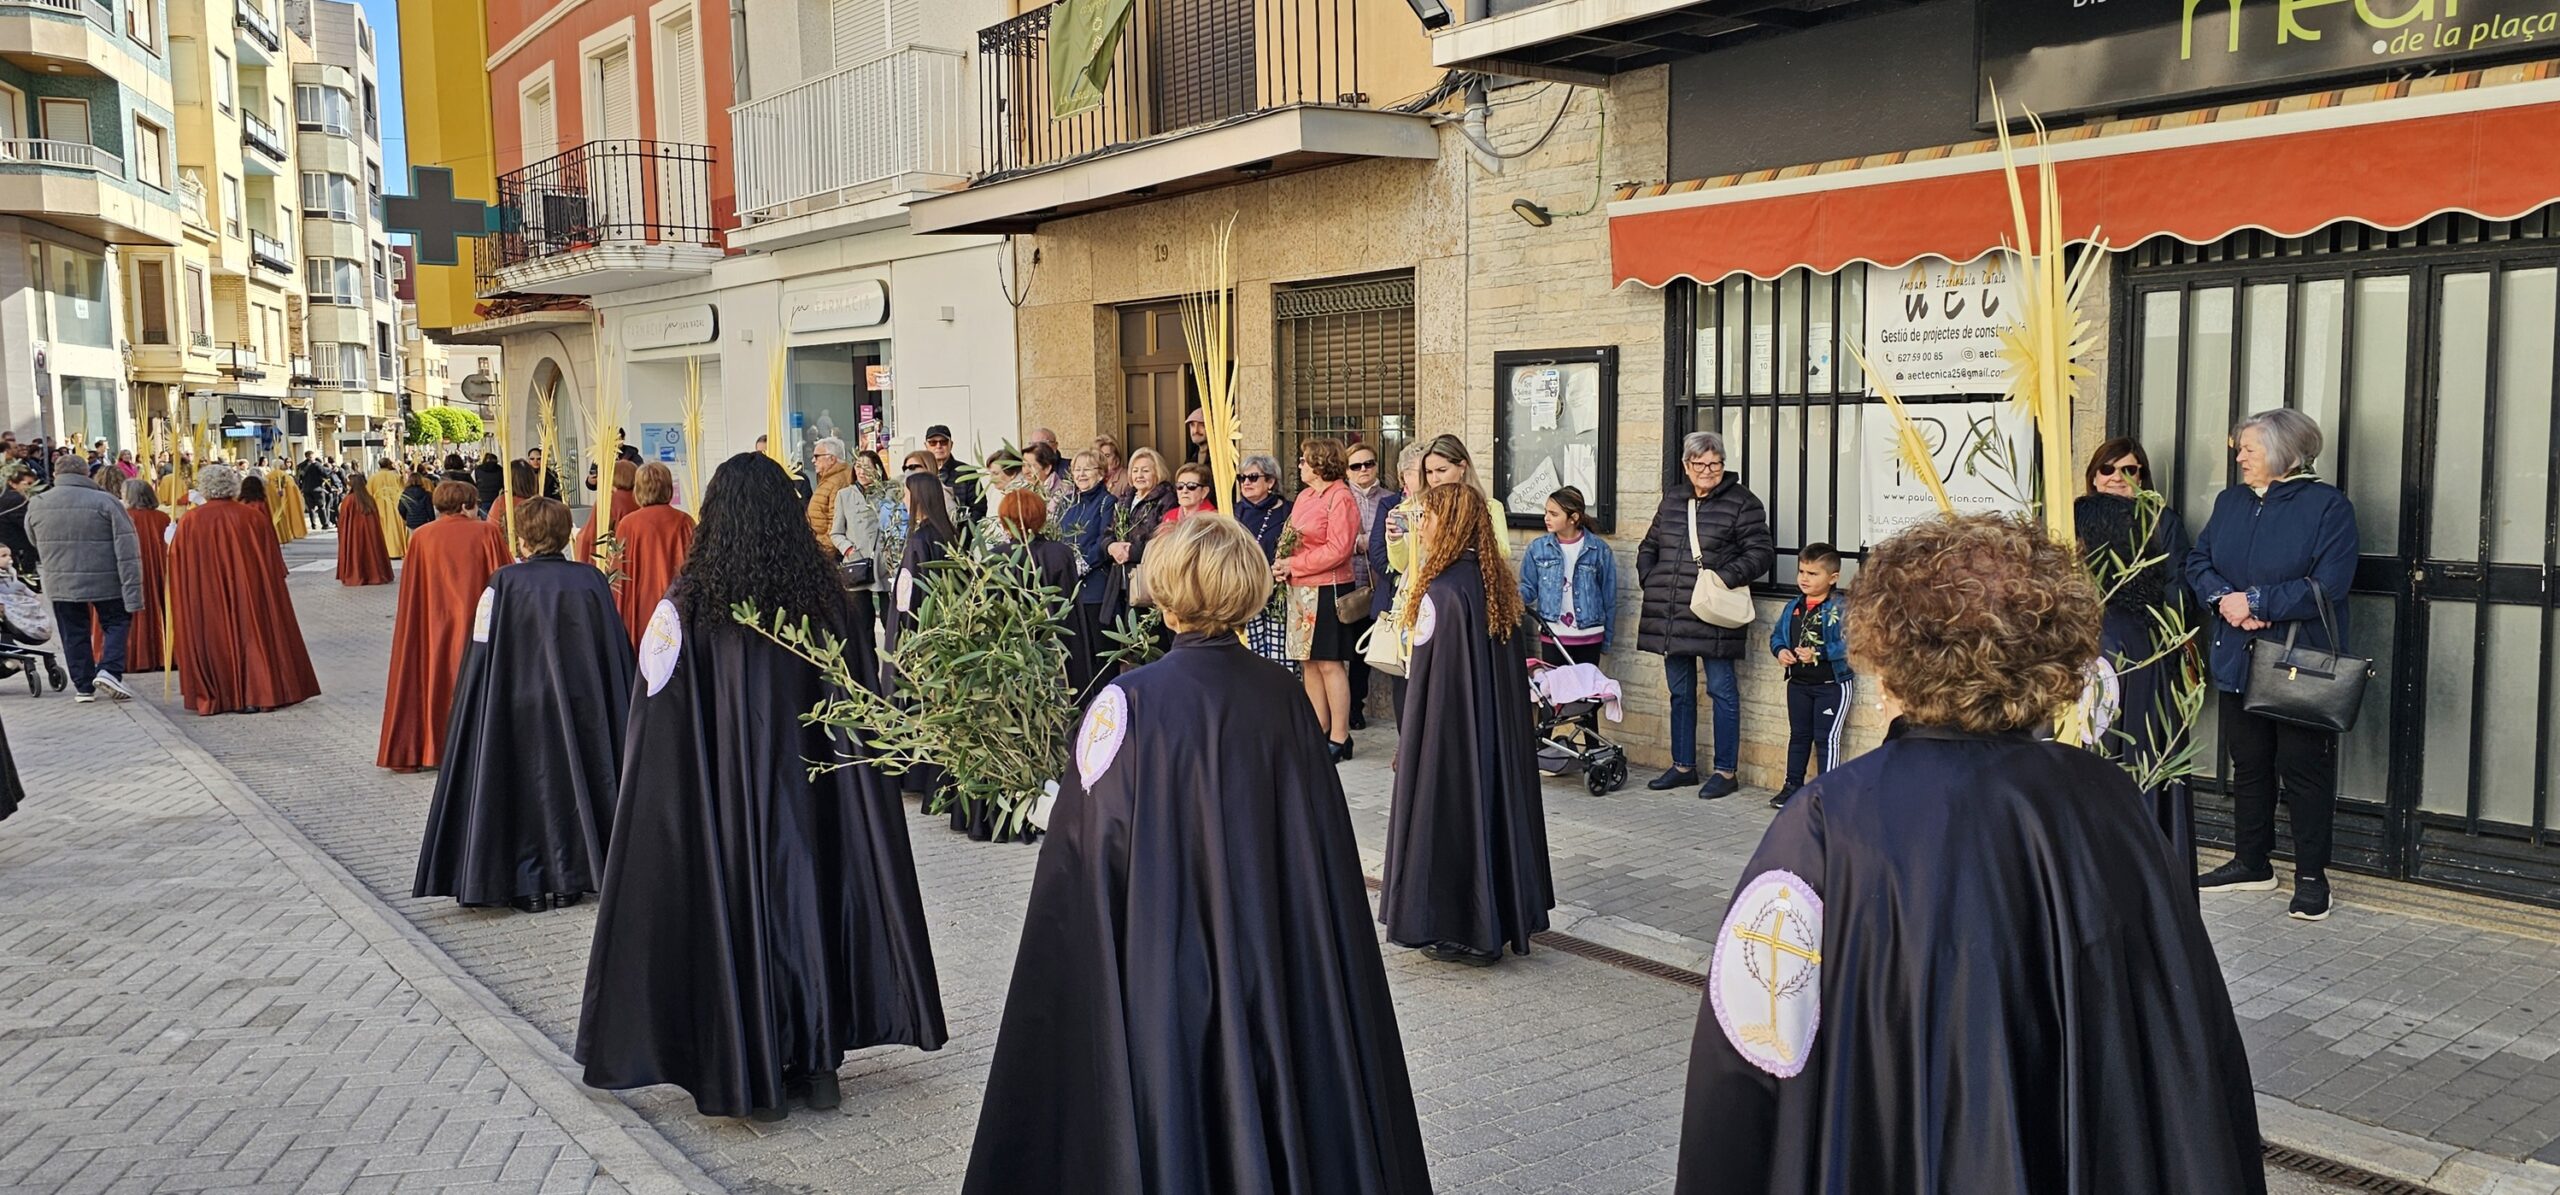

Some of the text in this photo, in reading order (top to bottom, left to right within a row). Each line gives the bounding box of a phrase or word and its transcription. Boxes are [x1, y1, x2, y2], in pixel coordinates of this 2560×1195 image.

[2433, 23, 2461, 48] la
[2468, 12, 2558, 50] plaça
[1154, 244, 1168, 262] 19
[1881, 326, 1908, 344] Gestió
[1910, 326, 1921, 342] de
[1922, 325, 1960, 345] projectes
[1962, 324, 1973, 339] de
[1897, 351, 1944, 362] 627 59 00 85
